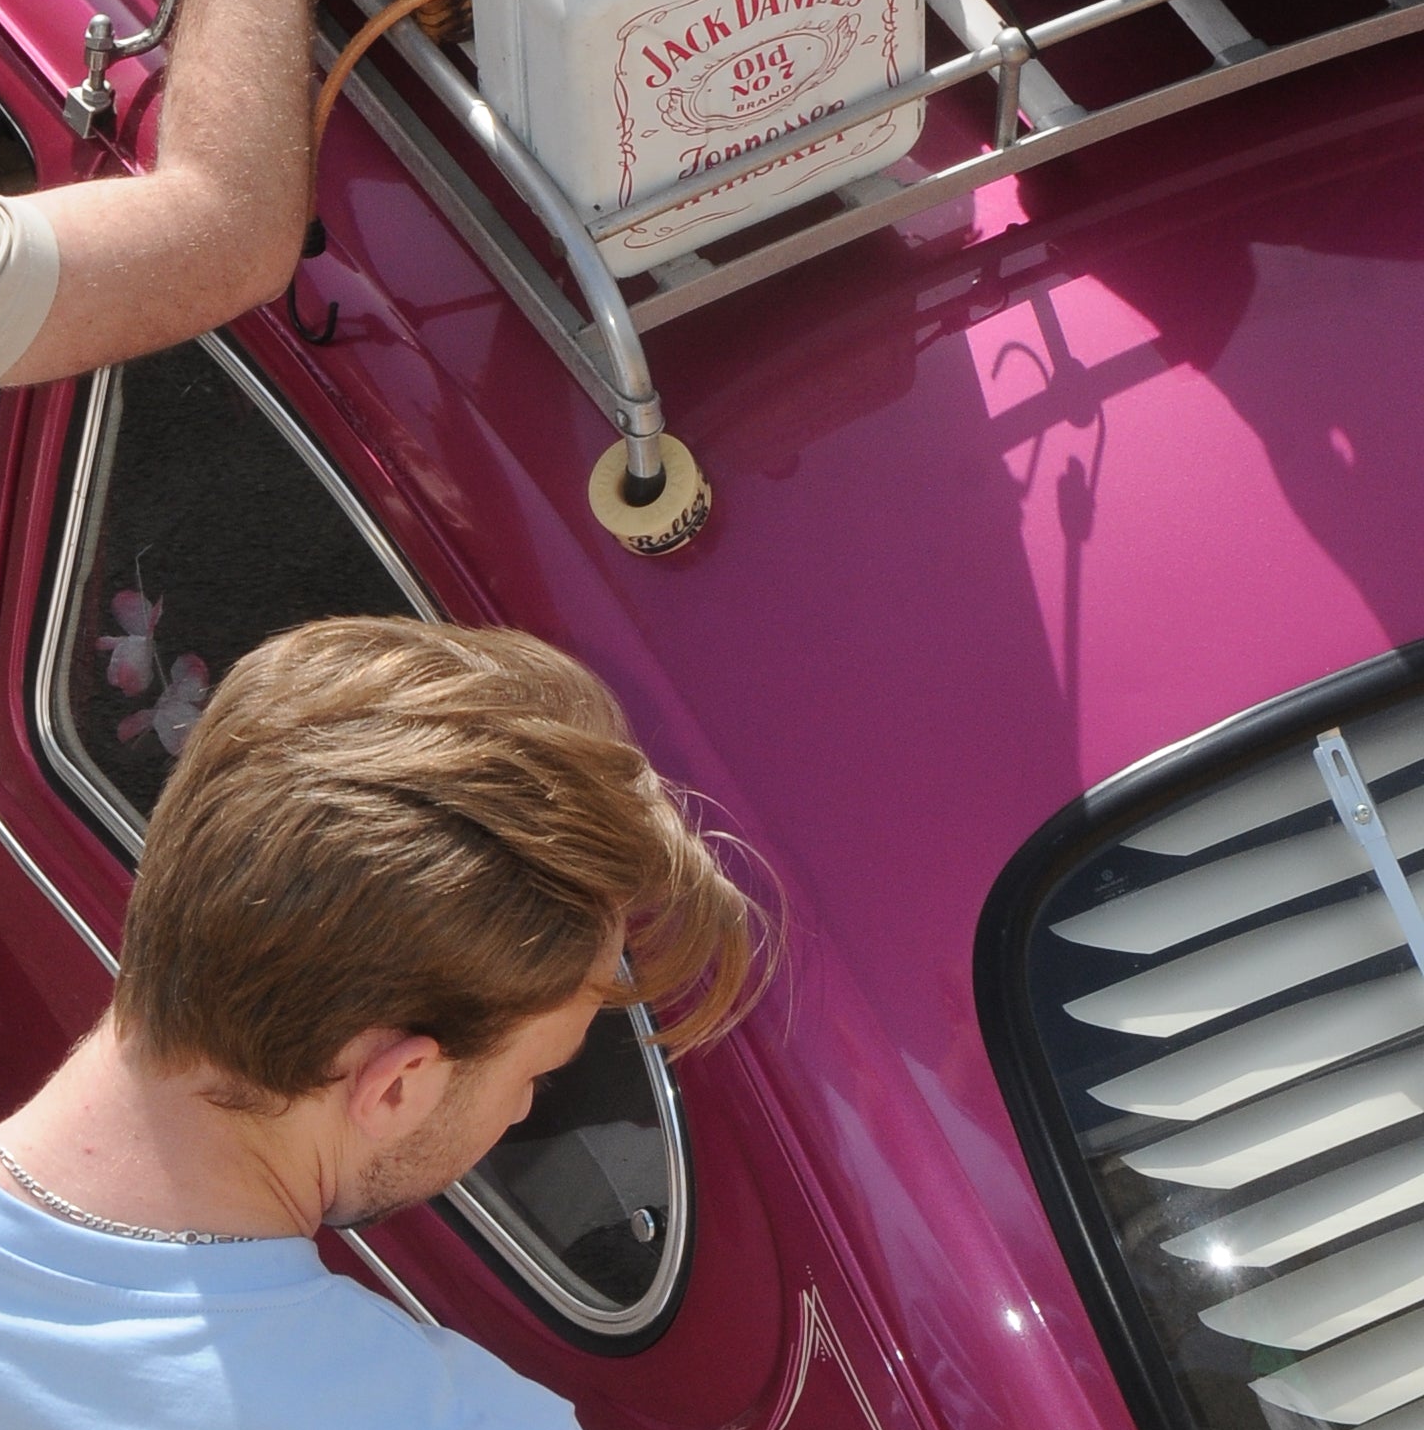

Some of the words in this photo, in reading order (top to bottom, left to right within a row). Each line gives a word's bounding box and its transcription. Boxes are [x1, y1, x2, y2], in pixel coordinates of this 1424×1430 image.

[641, 7, 733, 89] JACK
[733, 43, 789, 80] Old
[778, 60, 795, 80] 7
[736, 84, 792, 113] BRAND
